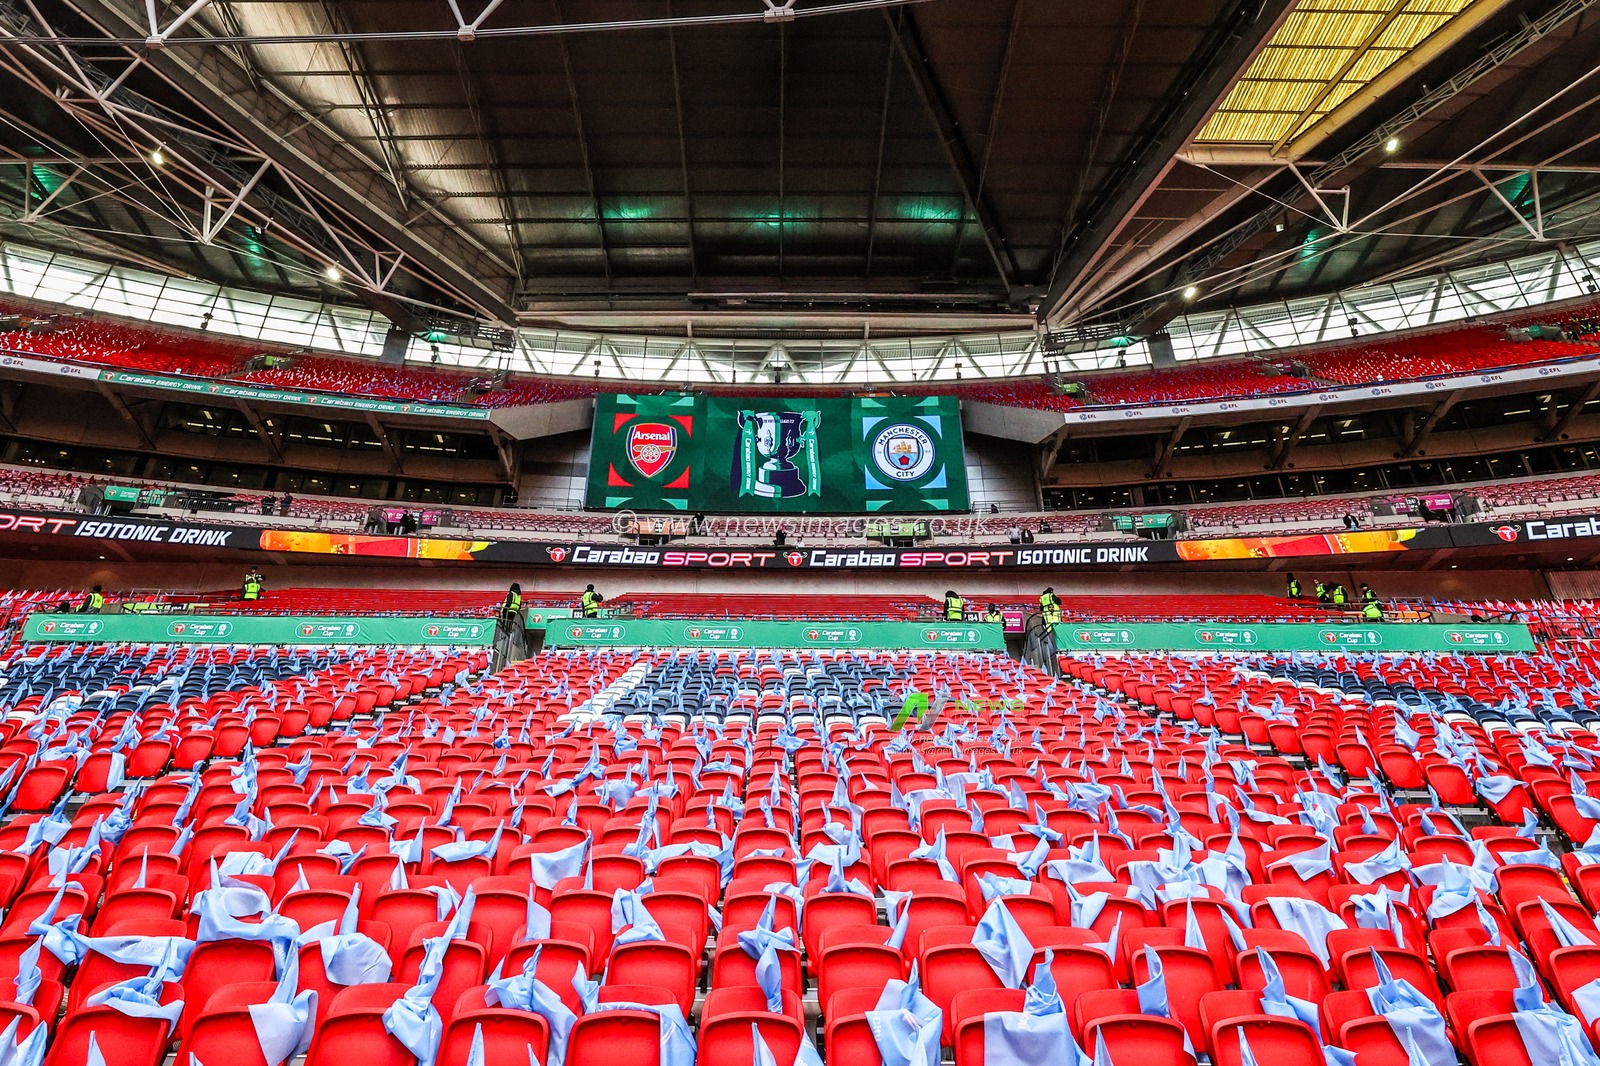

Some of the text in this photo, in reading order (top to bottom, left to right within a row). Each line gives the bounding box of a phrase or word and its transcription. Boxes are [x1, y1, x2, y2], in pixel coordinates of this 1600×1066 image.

[119, 374, 156, 384] Carabao
[223, 387, 258, 397] Carabao
[321, 397, 354, 407] Carabao
[414, 406, 446, 414] Carabao
[634, 431, 670, 441] Arsenal
[878, 427, 928, 446] MANCHESTER
[74, 520, 169, 542] ISOTONIC
[167, 529, 233, 546] DRINK
[571, 546, 776, 567] Carabao SPORT
[809, 546, 1149, 567] Carabao SPORT ISOTONIC DRINK
